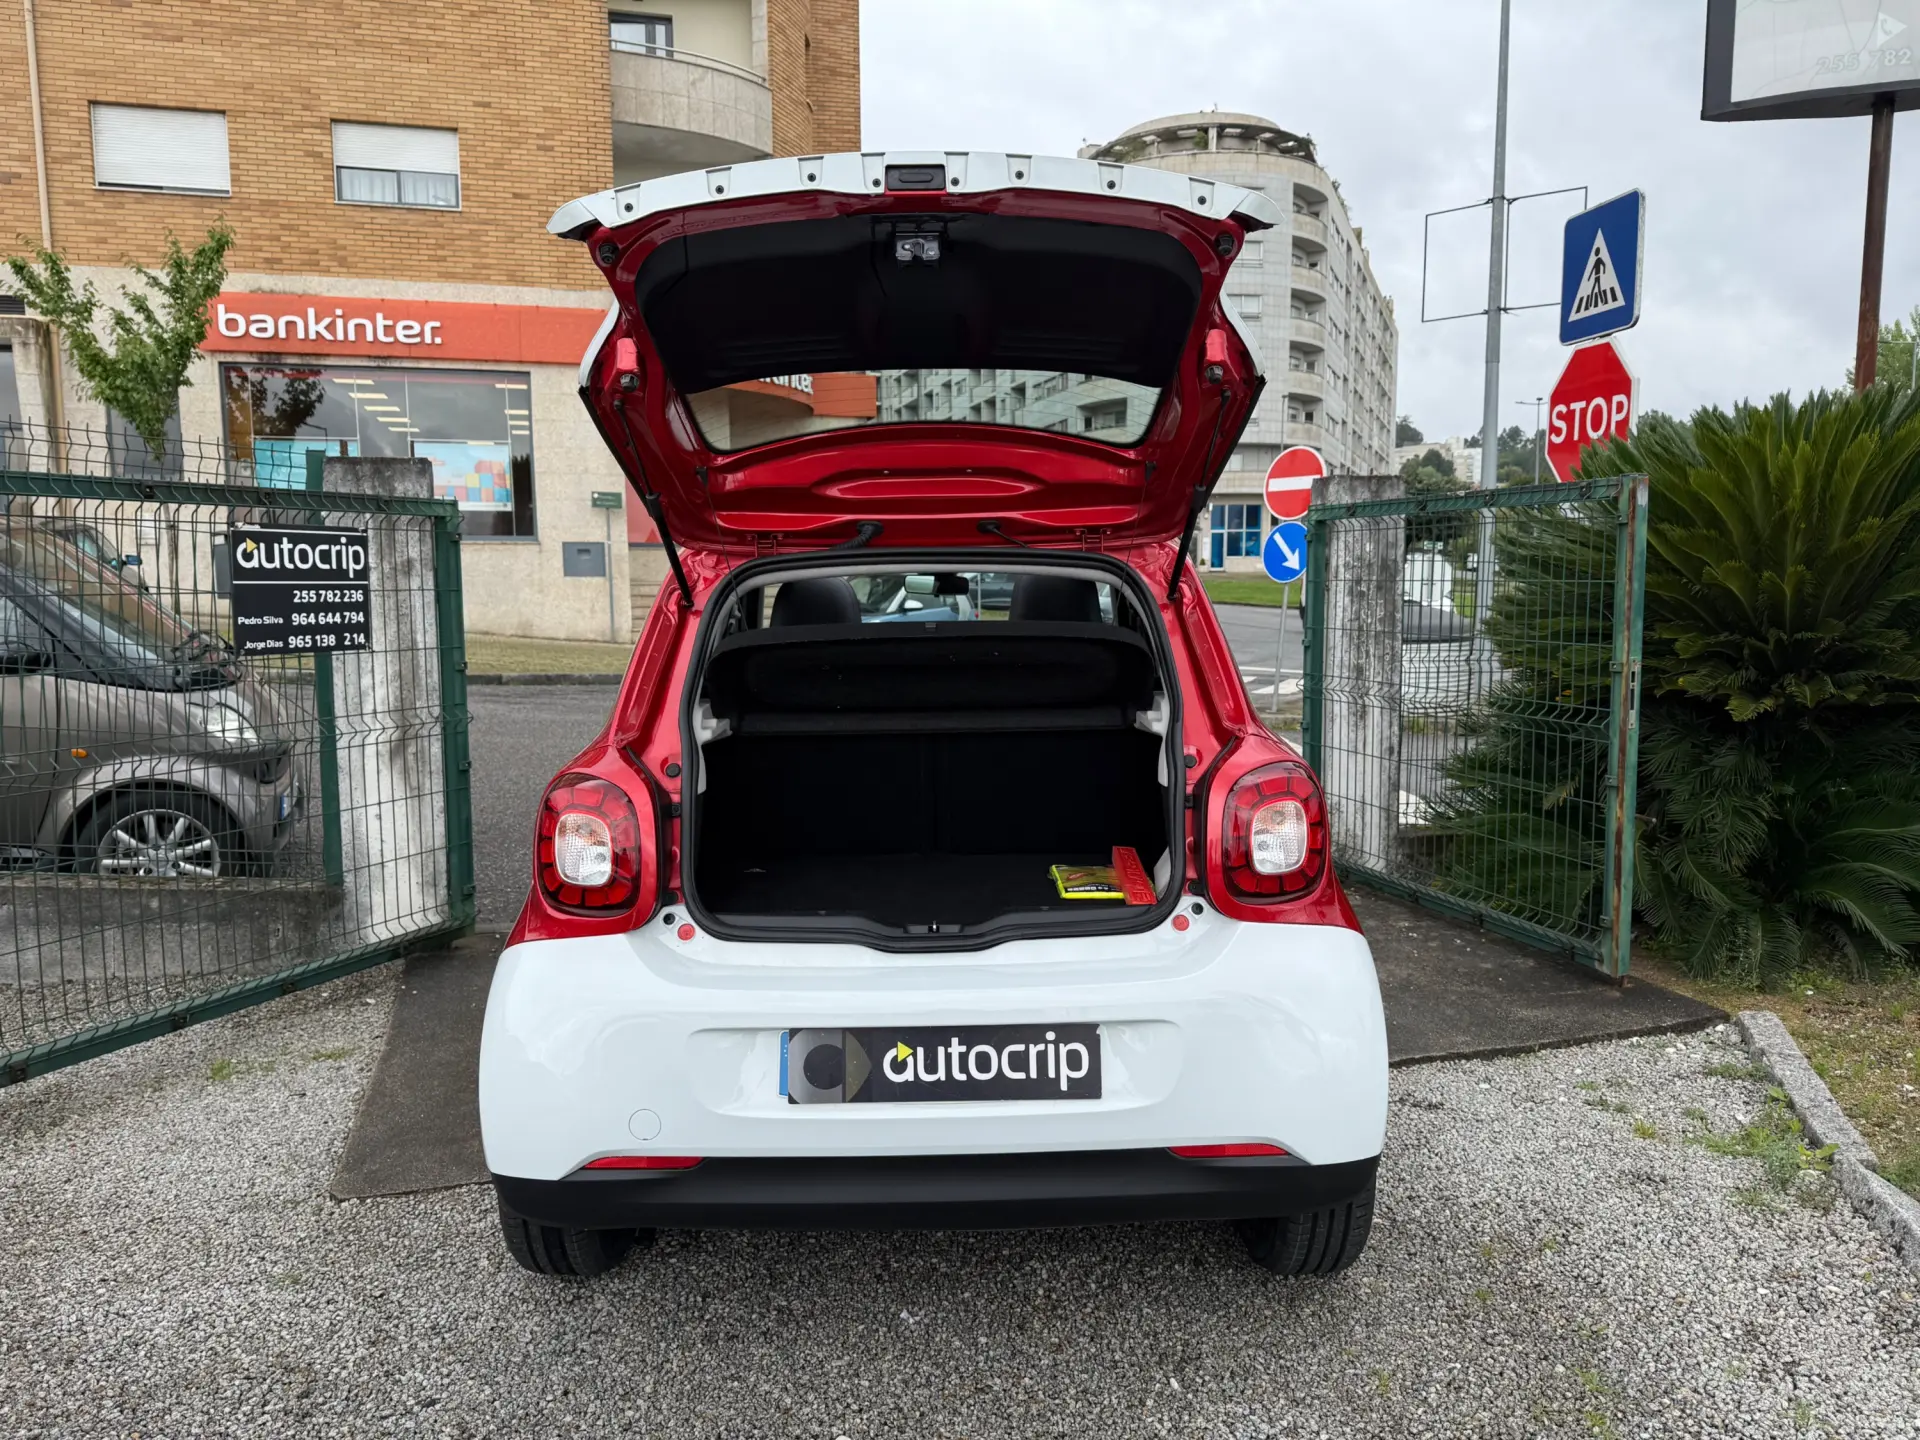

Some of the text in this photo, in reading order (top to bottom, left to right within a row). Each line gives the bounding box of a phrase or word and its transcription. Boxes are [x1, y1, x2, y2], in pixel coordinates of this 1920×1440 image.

[1815, 47, 1912, 75] 255 782
[1550, 393, 1629, 444] STOP
[236, 536, 366, 579] autocrip
[292, 590, 364, 603] 255 782 236
[237, 611, 365, 626] Pedro Silva 964 644 794
[244, 639, 266, 650] Jorge
[266, 638, 284, 648] Dias
[288, 634, 312, 648] 965
[315, 634, 336, 647] 138
[882, 1030, 1090, 1092] autocrip
